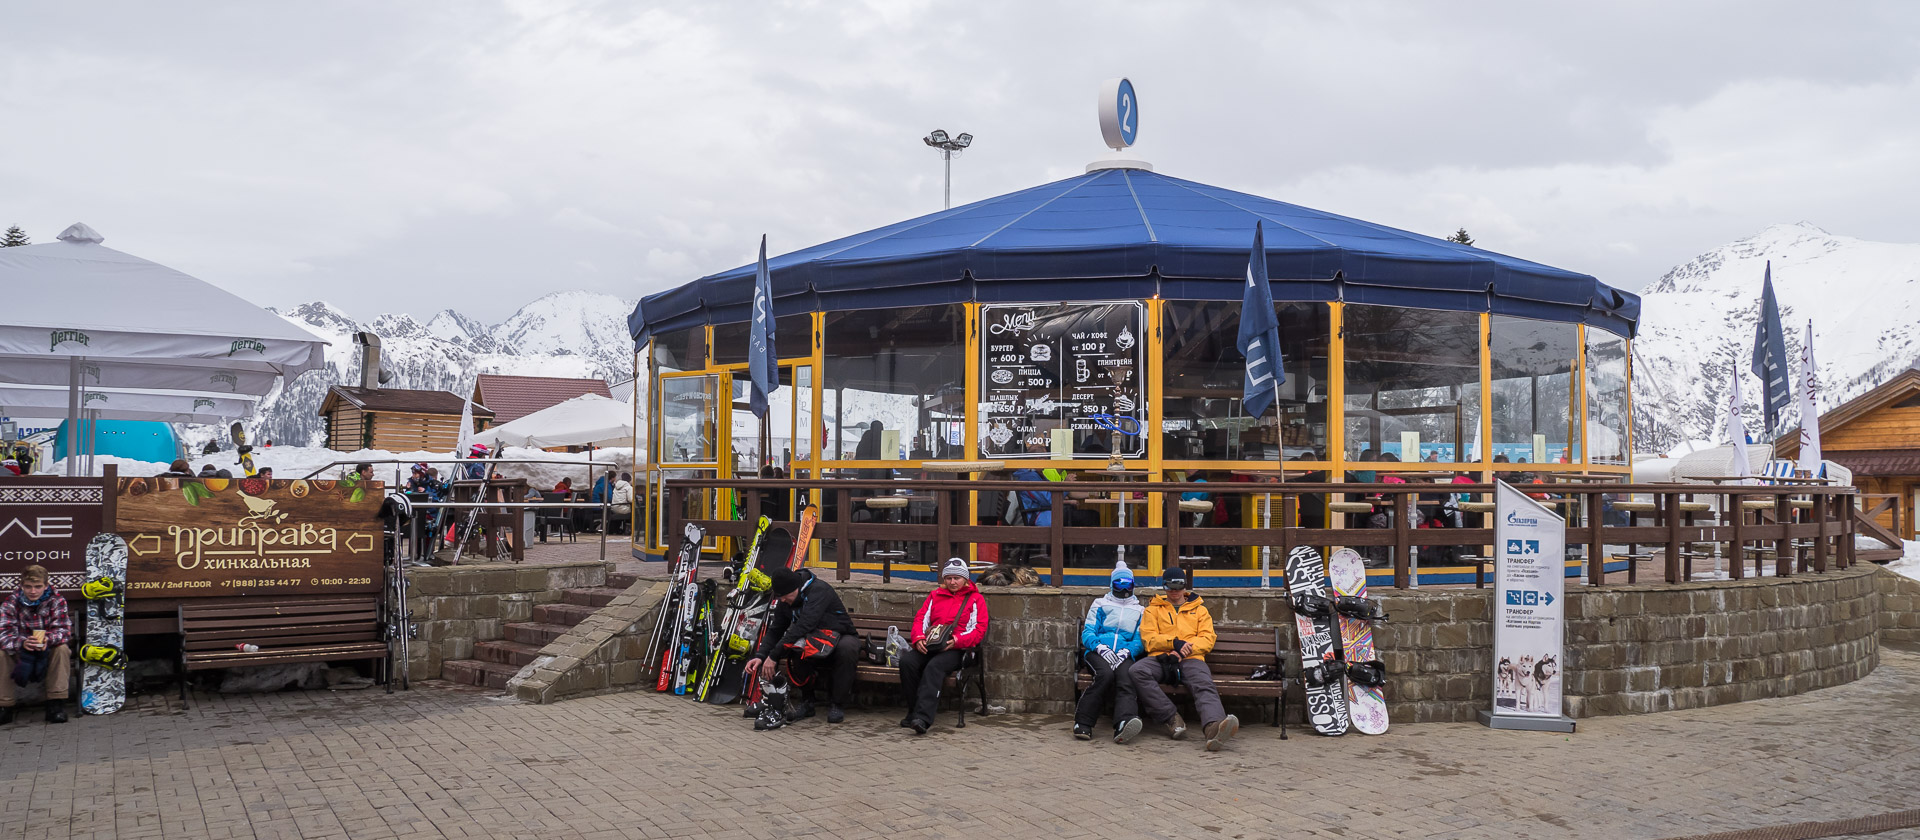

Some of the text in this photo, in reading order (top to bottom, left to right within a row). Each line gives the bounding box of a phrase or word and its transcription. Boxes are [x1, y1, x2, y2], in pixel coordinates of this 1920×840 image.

[1122, 93, 1130, 133] 2
[990, 310, 1037, 333] Menu
[0, 550, 70, 562] сторан
[203, 557, 311, 570] хинкальная
[232, 579, 257, 588] (988)
